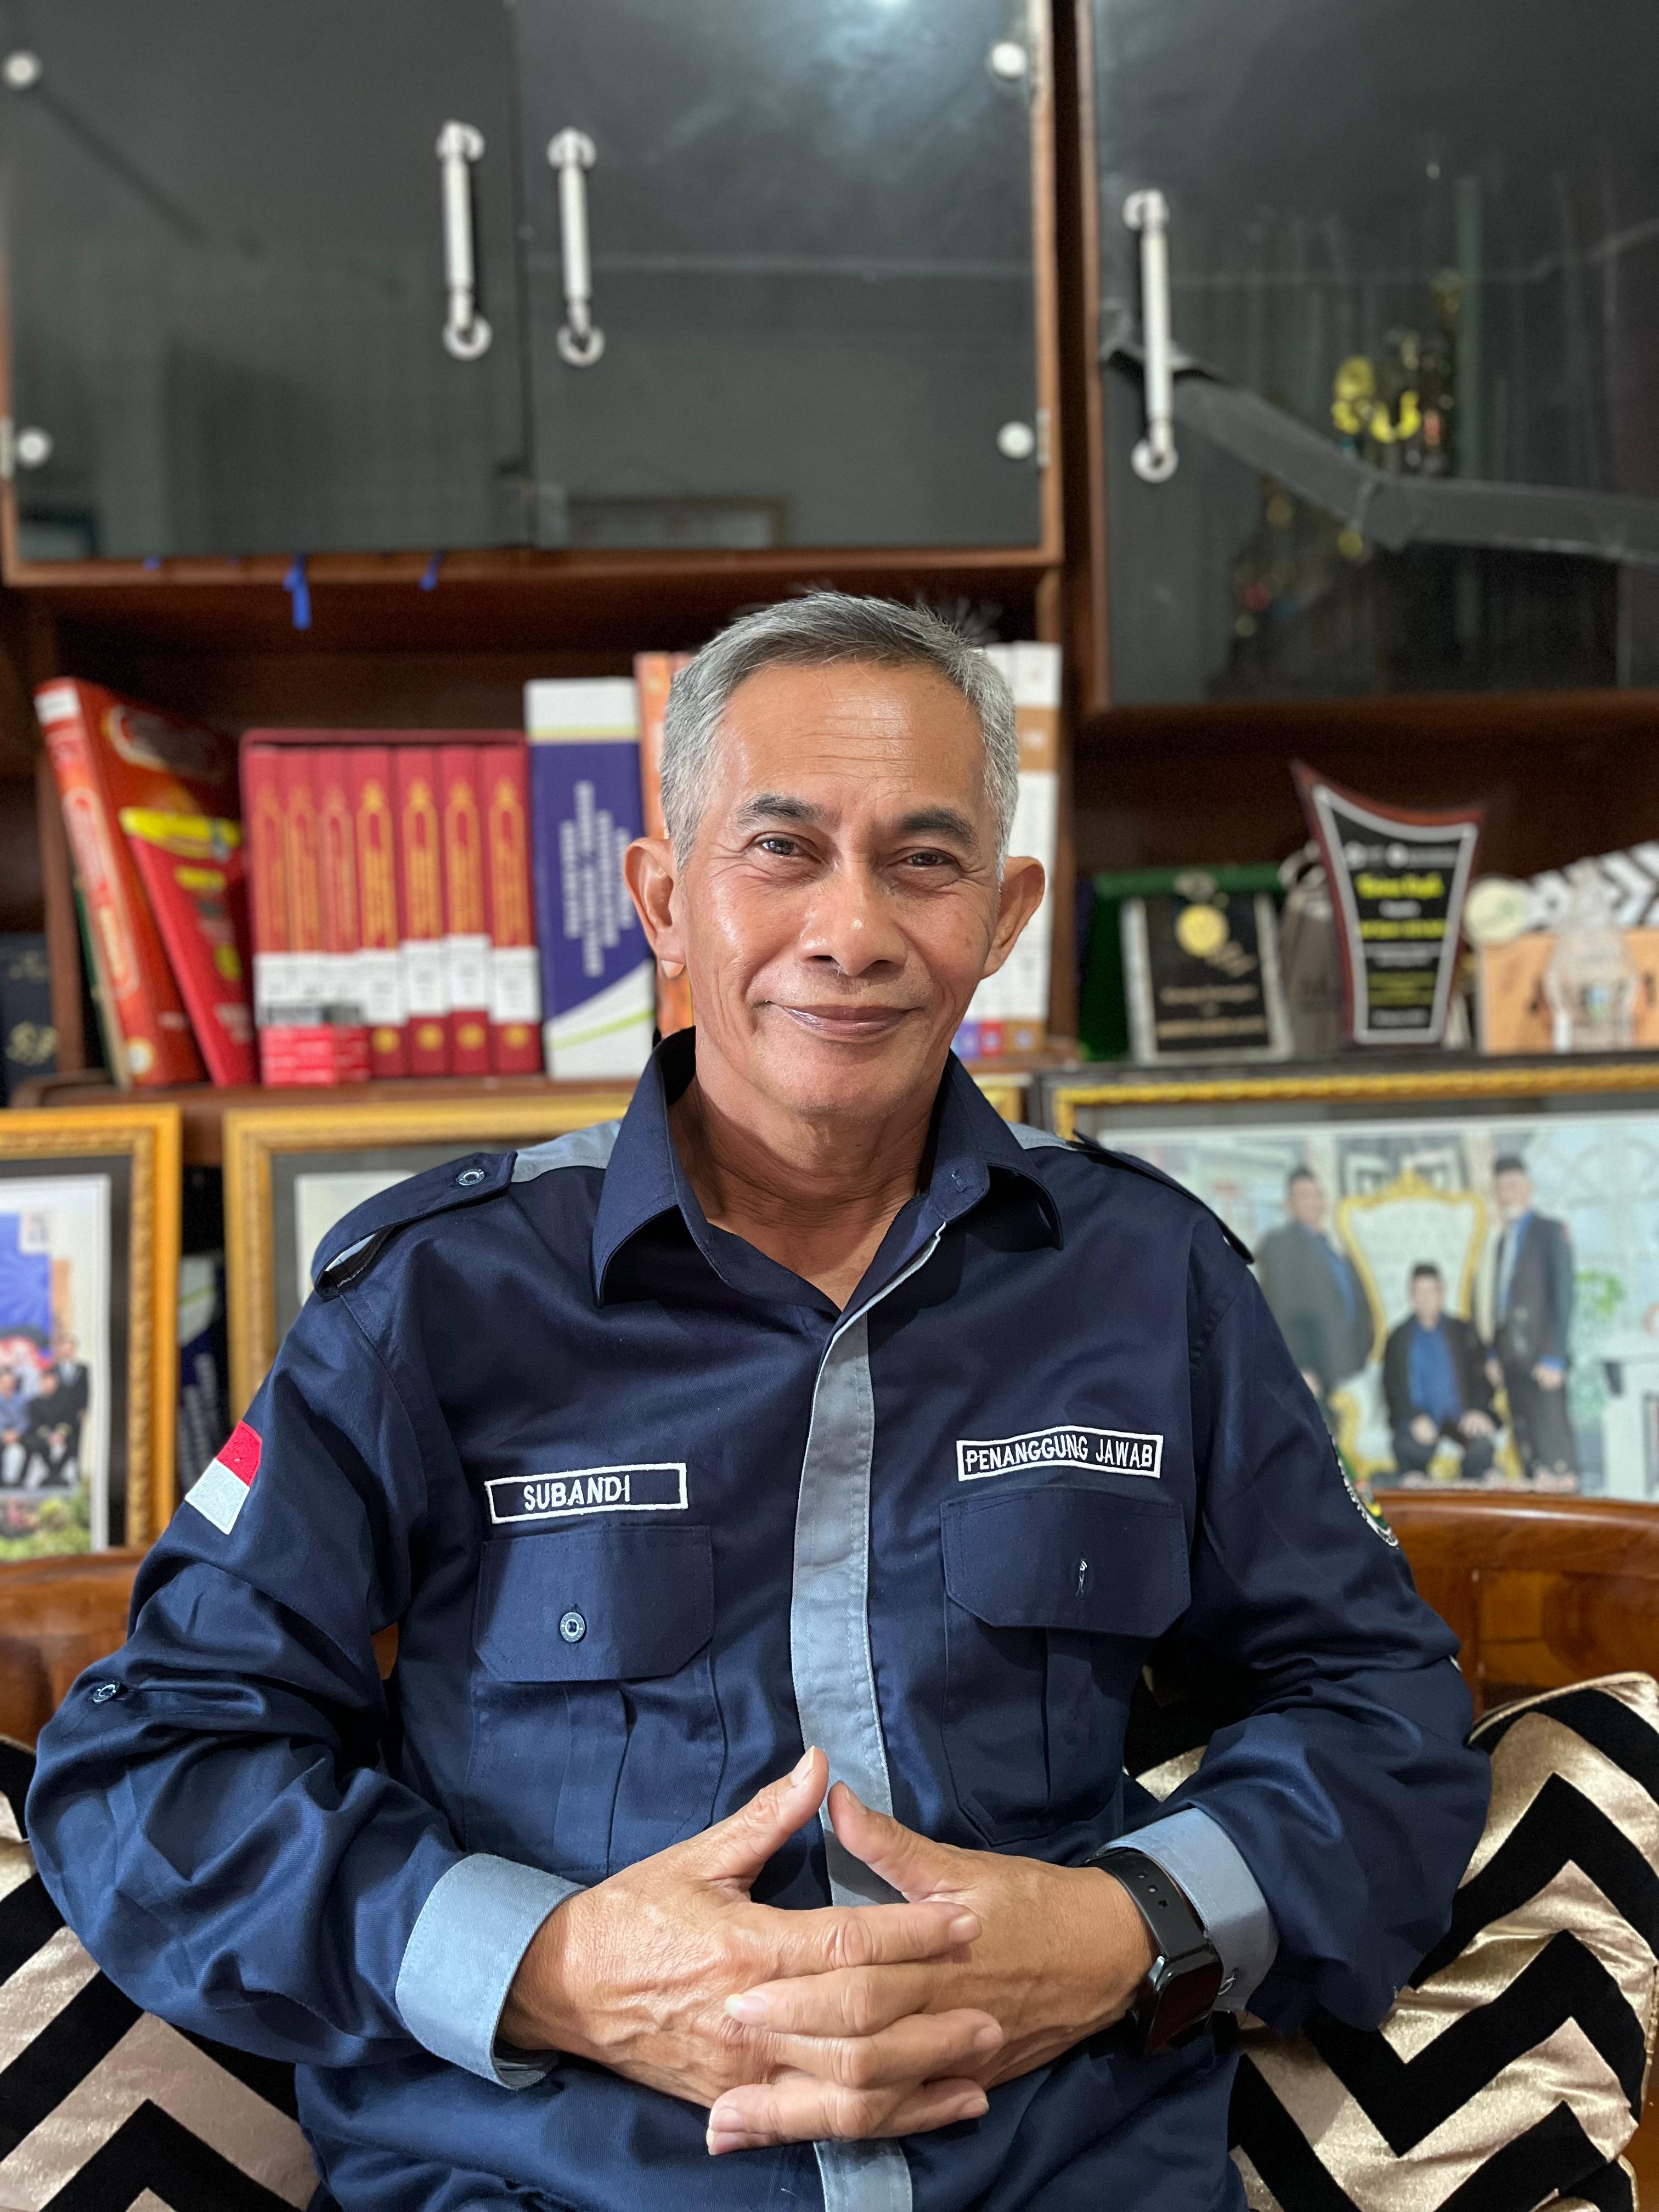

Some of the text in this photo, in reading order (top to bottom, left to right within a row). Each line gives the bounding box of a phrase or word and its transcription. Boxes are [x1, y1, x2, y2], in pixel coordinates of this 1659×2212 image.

[966, 1434, 1153, 1471] PENANGGUNG JAWAB
[523, 1475, 630, 1511] SUBANDI
